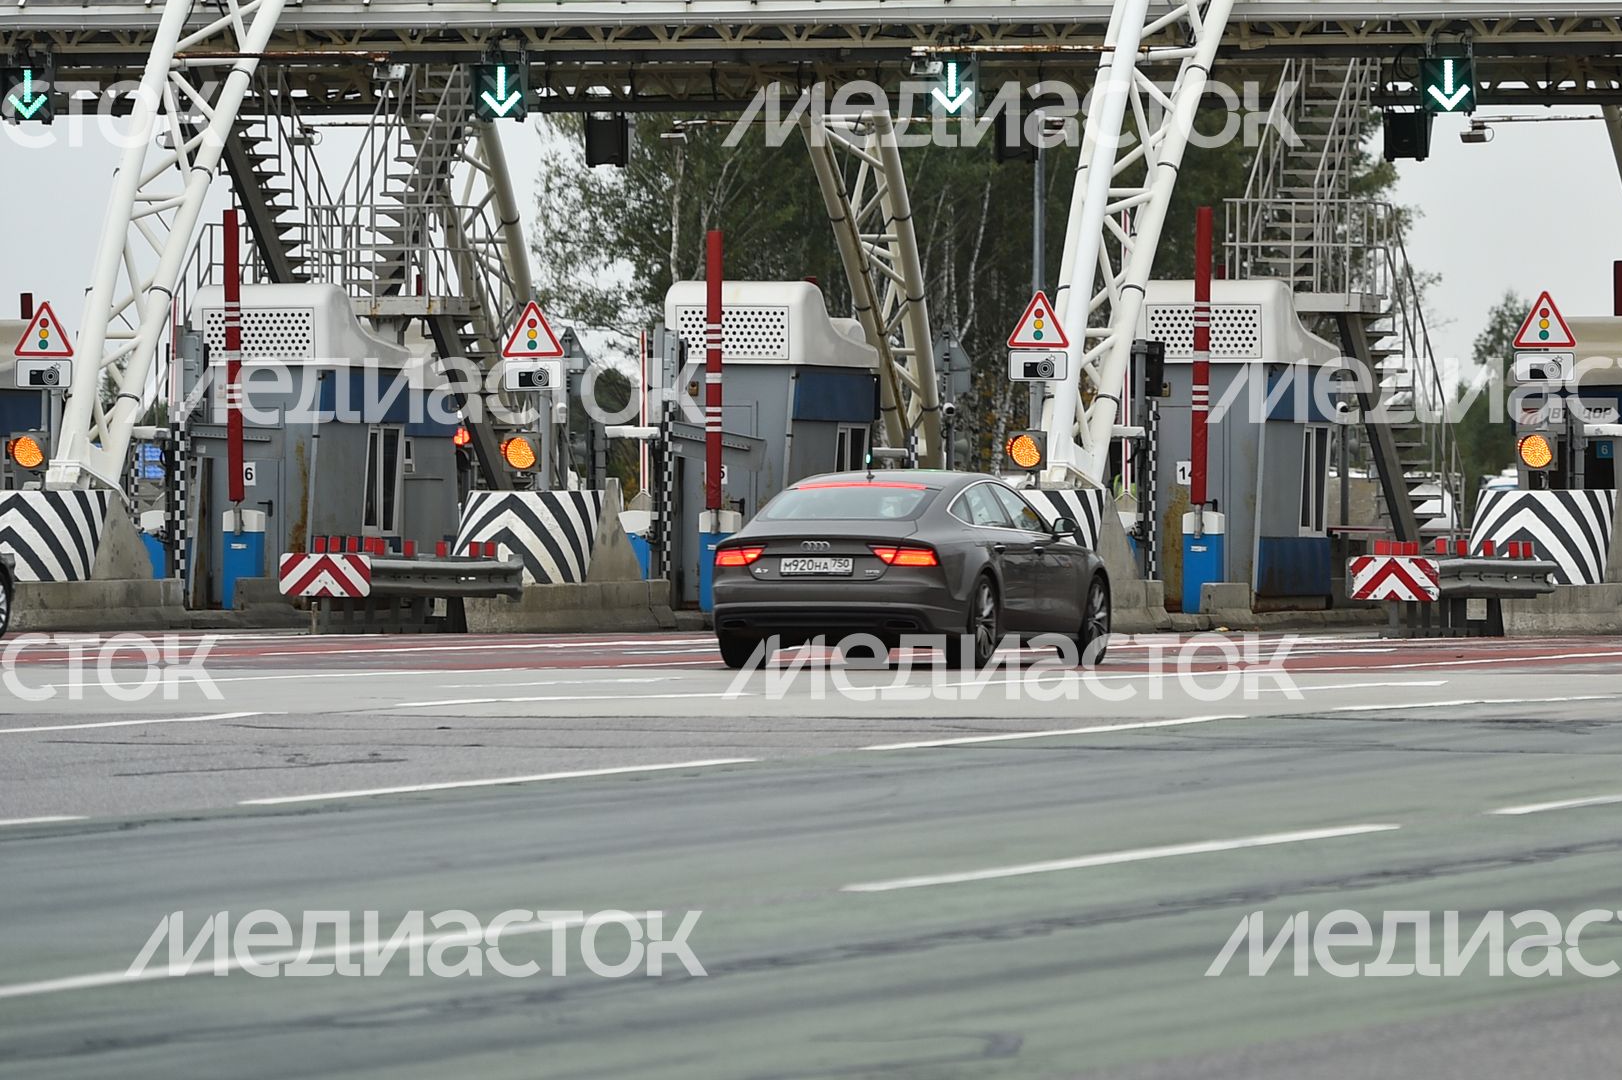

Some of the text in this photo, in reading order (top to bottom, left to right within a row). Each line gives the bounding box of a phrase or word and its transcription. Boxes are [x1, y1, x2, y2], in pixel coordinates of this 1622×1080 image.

[1547, 407, 1612, 420] ВТДОР
[1601, 444, 1609, 455] 6
[784, 558, 850, 571] М920НА 750
